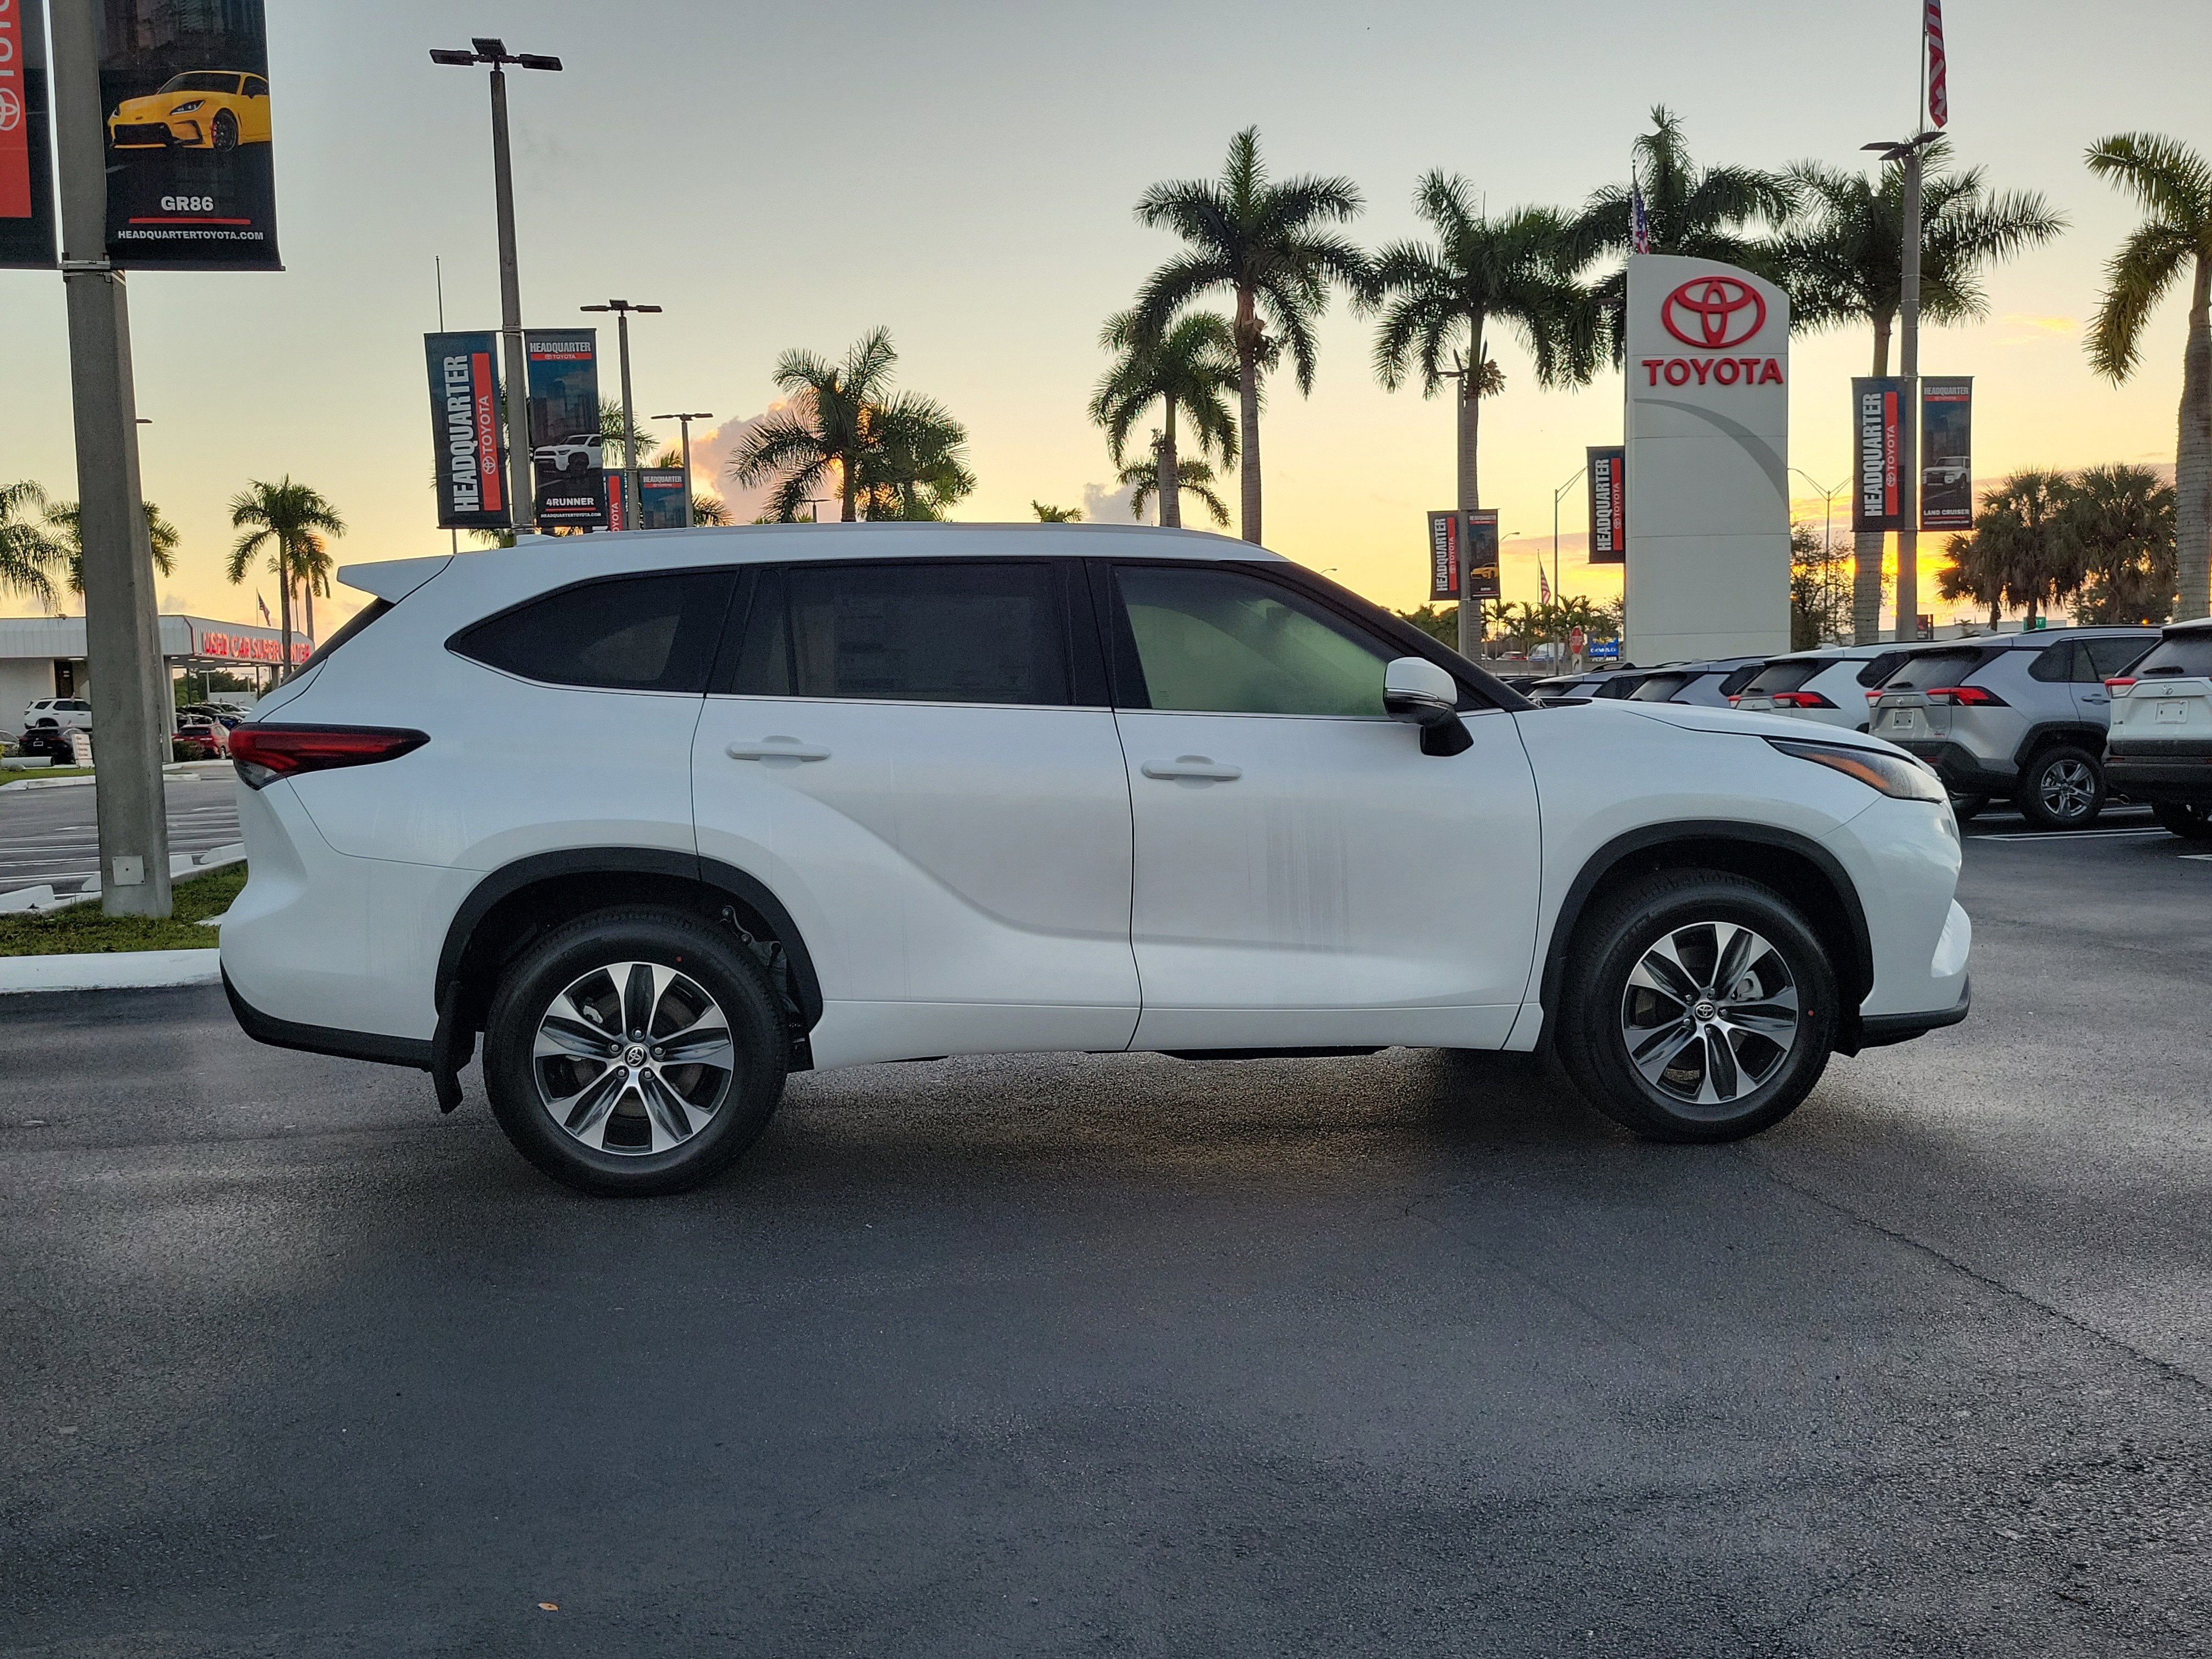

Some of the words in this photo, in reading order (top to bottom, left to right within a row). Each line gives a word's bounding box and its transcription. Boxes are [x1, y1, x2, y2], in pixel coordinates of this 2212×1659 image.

[161, 196, 214, 211] GR86
[117, 230, 264, 240] HEADQUARTERTOYOTA.COM
[529, 342, 591, 353] HEADQUARTER
[1641, 358, 1784, 386] TOYOTA
[443, 355, 480, 512] HEADQUARTER
[479, 395, 494, 455] TOYOTA
[1863, 393, 1885, 516] HEADQUARTER
[1887, 425, 1895, 471] TOYOTA
[546, 498, 594, 506] 4RUNNER
[1595, 459, 1613, 551] HEADQUARTER
[611, 503, 620, 533] OYOTA
[1435, 518, 1448, 591] HEADQUARTER
[204, 632, 229, 656] USED
[232, 635, 251, 658] CAR
[252, 638, 279, 661] SUPER
